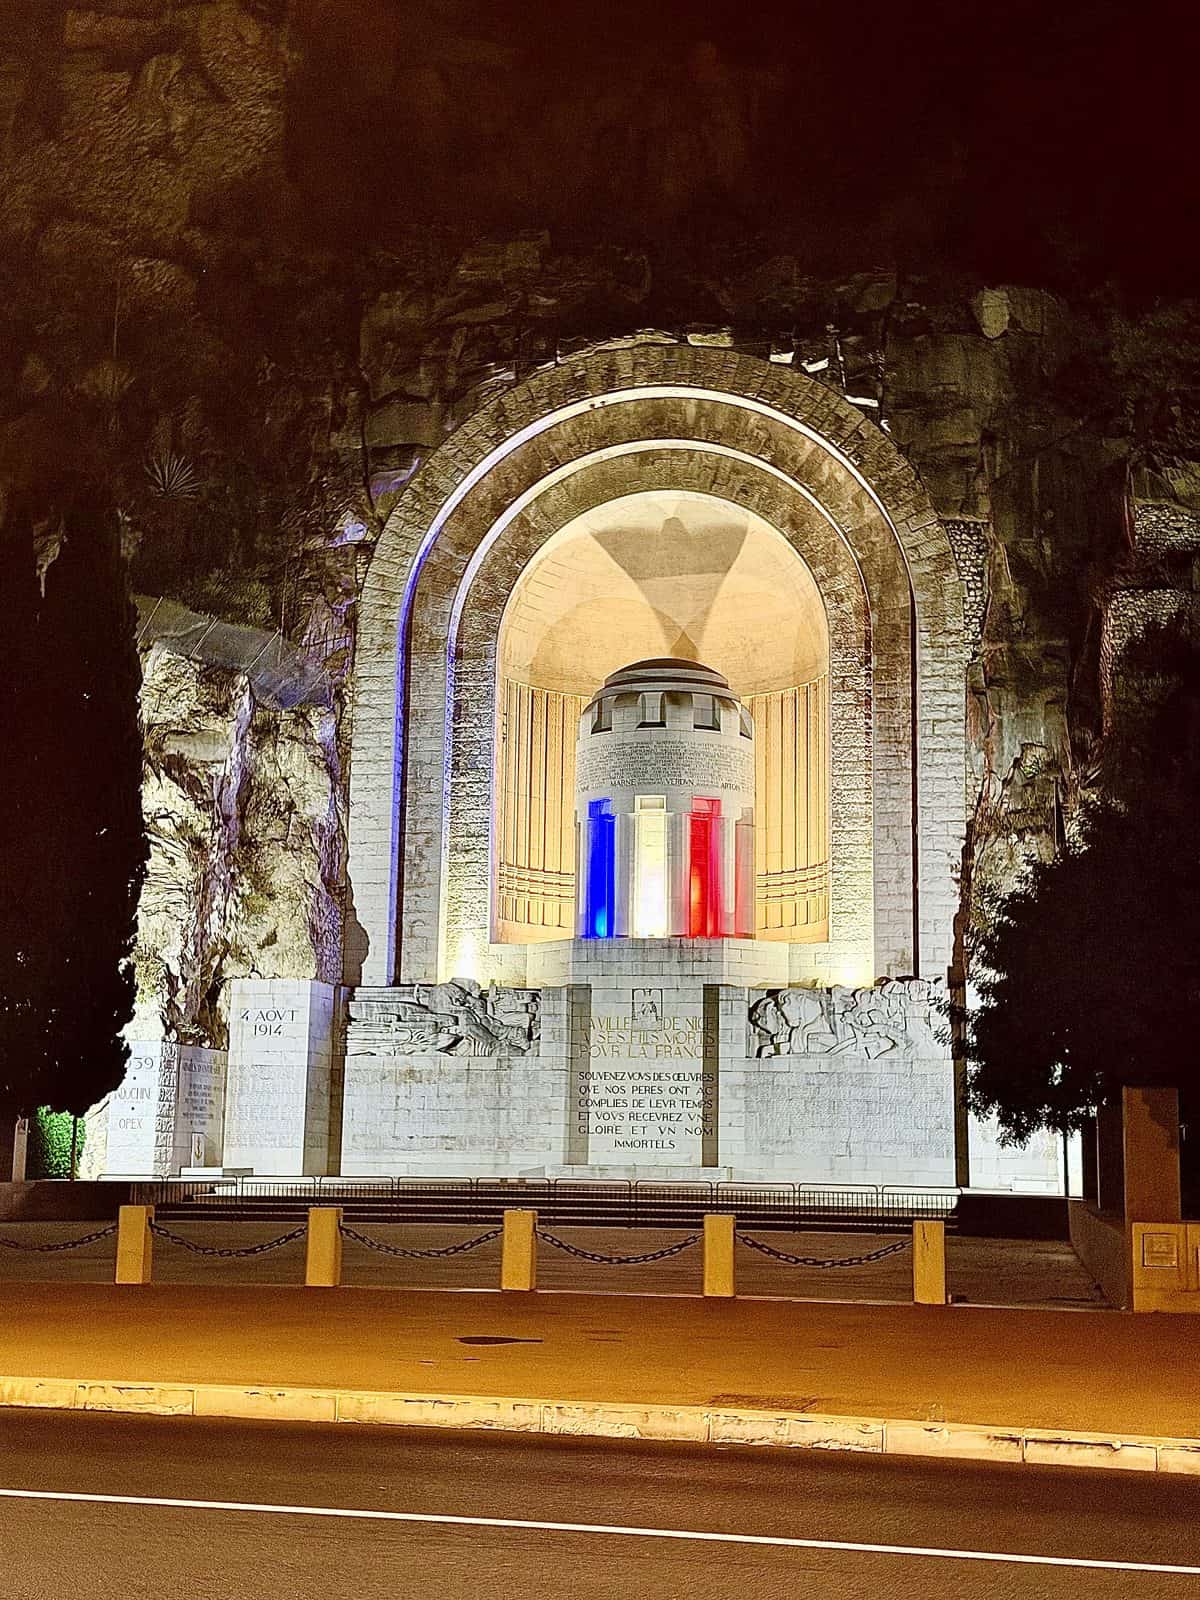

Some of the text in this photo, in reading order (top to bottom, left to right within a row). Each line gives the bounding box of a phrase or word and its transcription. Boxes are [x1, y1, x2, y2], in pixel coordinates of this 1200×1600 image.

[241, 1010, 299, 1021] 4 AOVT
[598, 1017, 631, 1030] VILLE
[663, 1017, 680, 1031] DE
[254, 1024, 282, 1036] 1914
[599, 1031, 627, 1044] SES
[628, 1045, 648, 1058] LA
[655, 1045, 714, 1058] FRANCE
[653, 1072, 671, 1081] DES
[605, 1085, 626, 1095] NOS
[631, 1085, 663, 1095] PERES
[668, 1085, 690, 1095] ONT
[696, 1087, 713, 1096] AC
[578, 1098, 713, 1109] COMPLIES DE LEVR TEMPS
[578, 1111, 592, 1121] ET
[595, 1111, 625, 1121] VOVS
[629, 1112, 682, 1121] RECEVREZ
[578, 1125, 714, 1136] GLOIRE ET VN NOM
[614, 1139, 676, 1150] IMMORTELS
